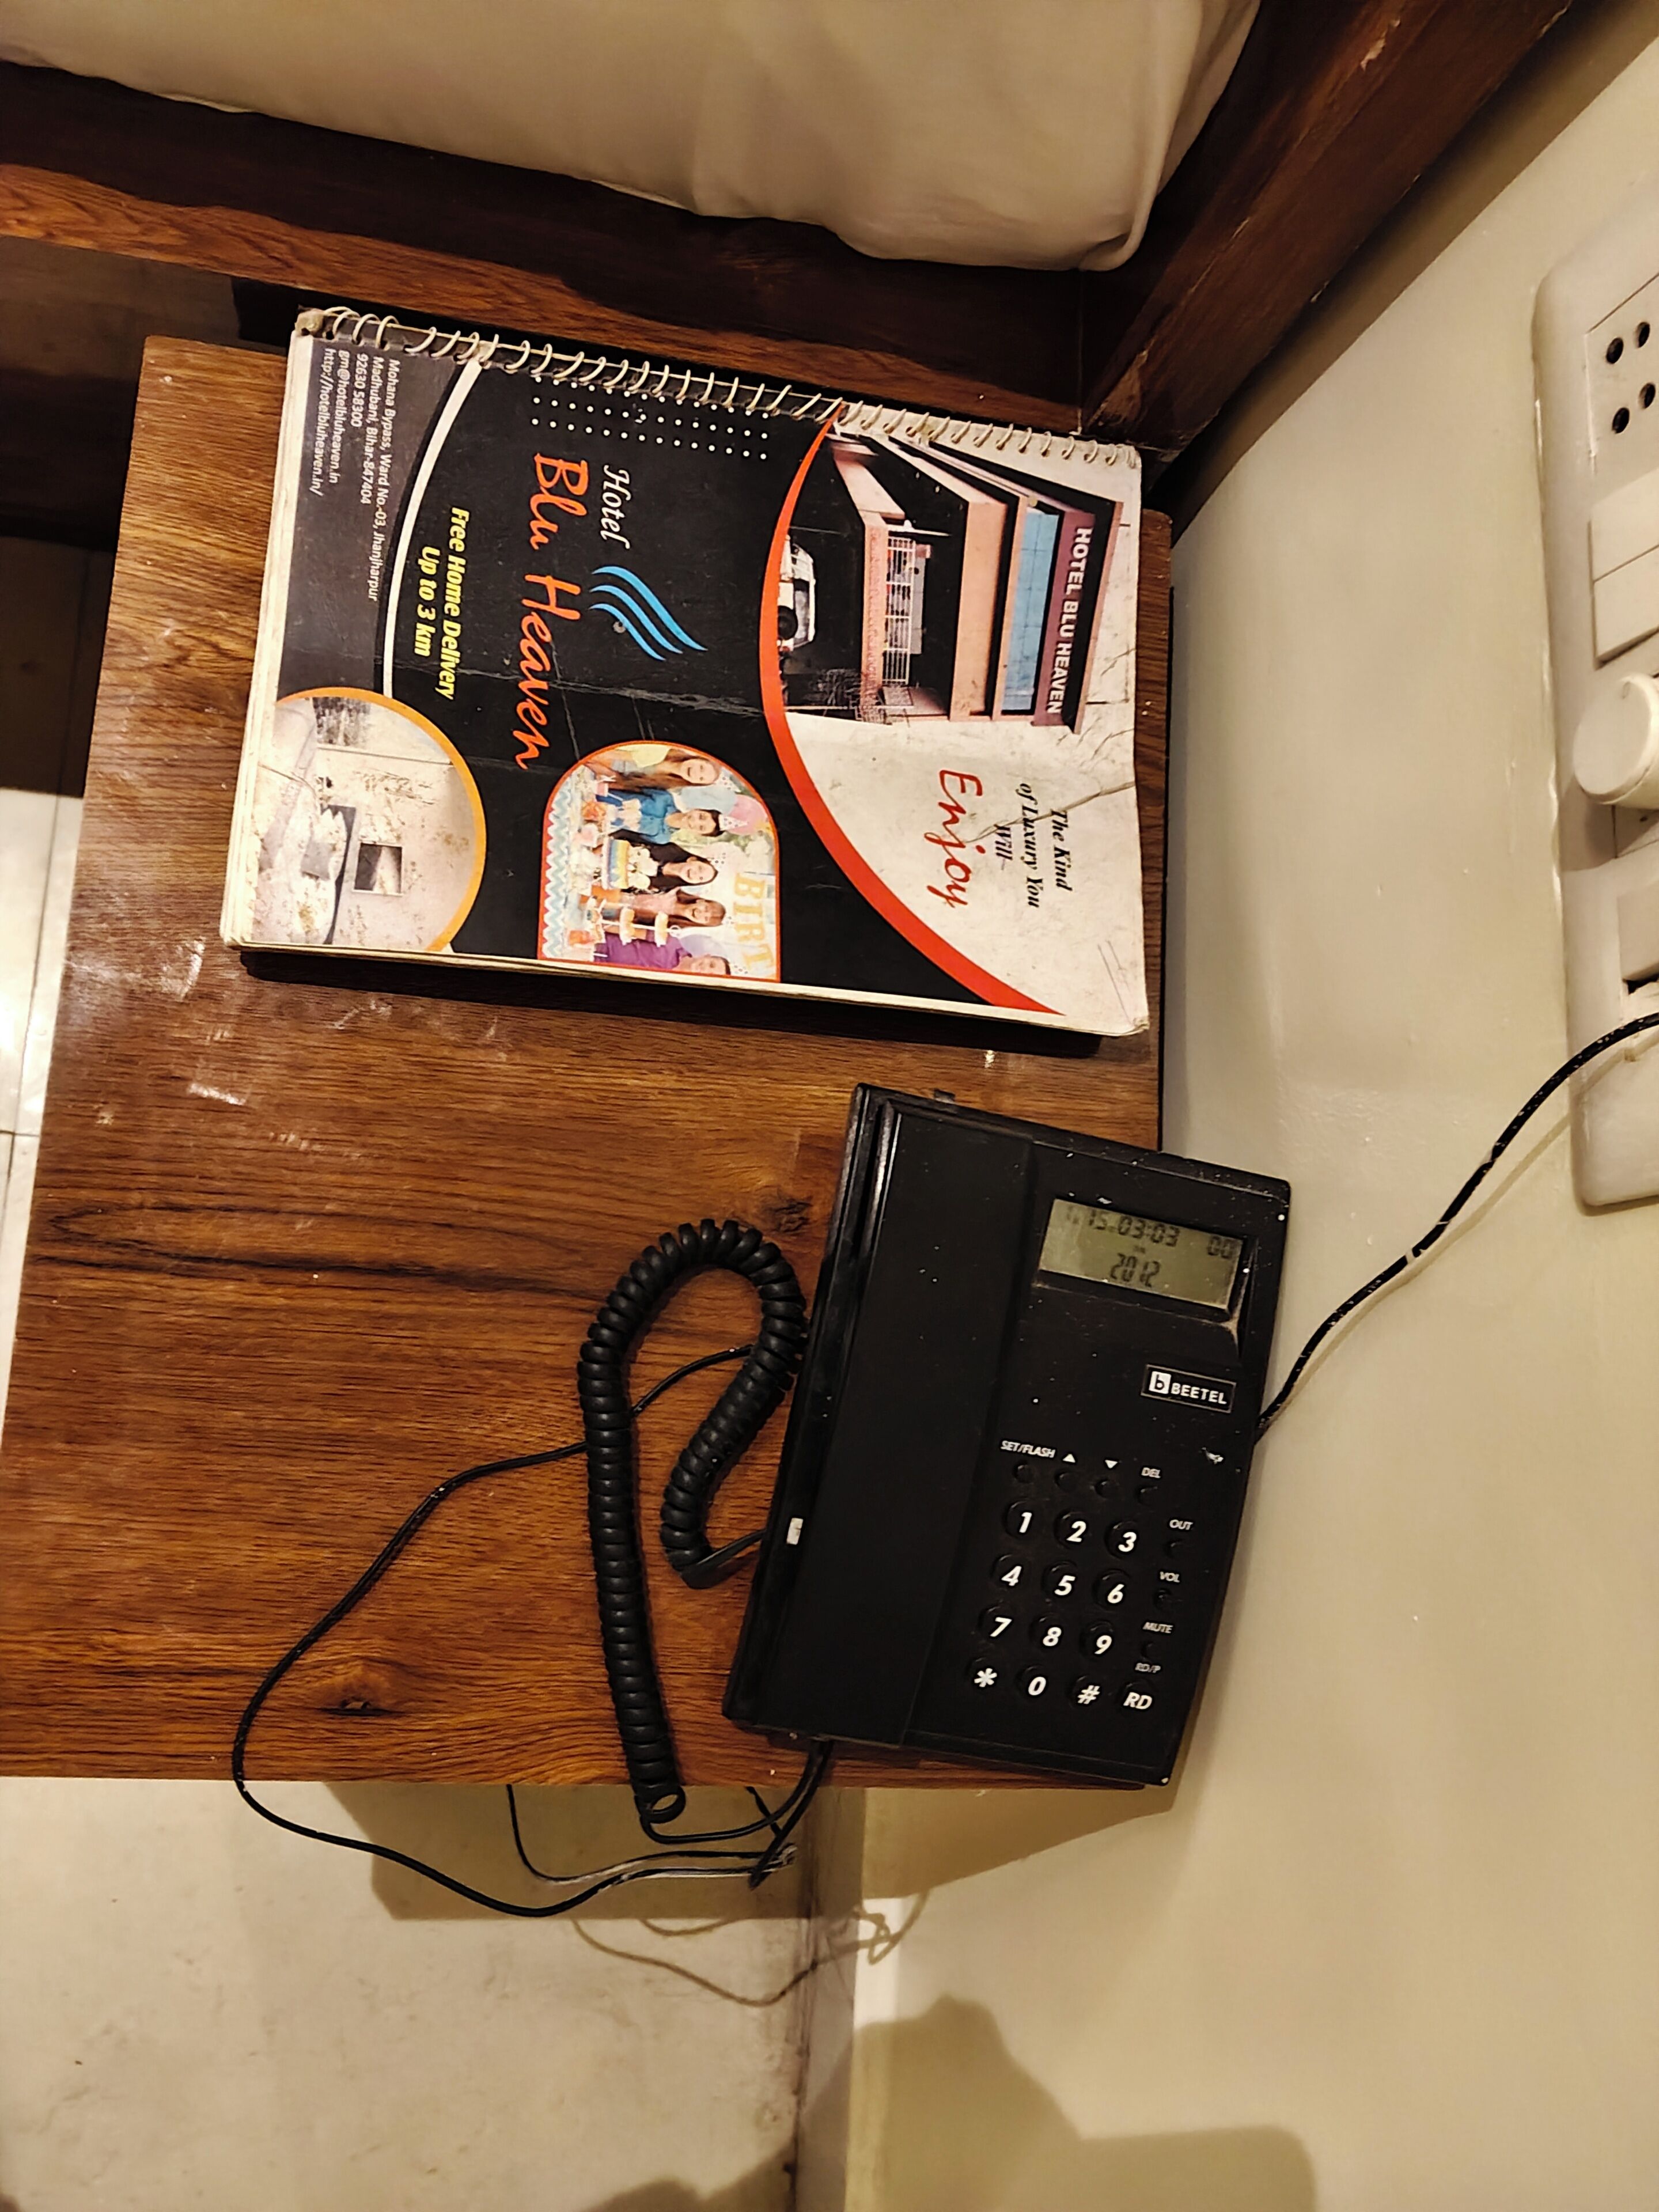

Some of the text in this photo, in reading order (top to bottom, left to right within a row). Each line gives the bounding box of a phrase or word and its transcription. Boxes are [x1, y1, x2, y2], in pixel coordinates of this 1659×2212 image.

[309, 348, 336, 497] http://hotelbluheaven.in/
[328, 350, 350, 483] gm@hotelbluheaven.in
[350, 353, 369, 427] 92630 58300
[360, 356, 384, 504] Madhubani, Bihar-847404
[367, 359, 400, 601] Mohana Bypass, Ward No.-03, Jhanjharpur
[600, 464, 630, 550] Hotel
[414, 546, 441, 657] Up to 3 km
[435, 507, 470, 700] Free Home Delivery
[512, 453, 589, 770] Blu Heaven
[1047, 528, 1094, 714] HOTEL BLU HEAVEN
[924, 770, 986, 908] Enjoy
[994, 824, 1013, 860] Will
[1015, 783, 1043, 908] of Luxury You
[1050, 809, 1073, 891] The Kind
[733, 872, 775, 978] BIRT
[1171, 1382, 1228, 1404] BEETEL
[1000, 1440, 1056, 1459] SET/FLASH
[1141, 1467, 1161, 1479] DEL
[1018, 1512, 1137, 1552] 1 2 3
[1169, 1519, 1194, 1531] OUT
[1001, 1565, 1124, 1604] 4 5 6
[1160, 1571, 1180, 1583] VOL
[990, 1616, 1112, 1654] 7 8 9
[1142, 1622, 1173, 1634] MUTE
[1028, 1676, 1047, 1696] 0
[1077, 1685, 1100, 1705] #
[1123, 1692, 1153, 1710] RD
